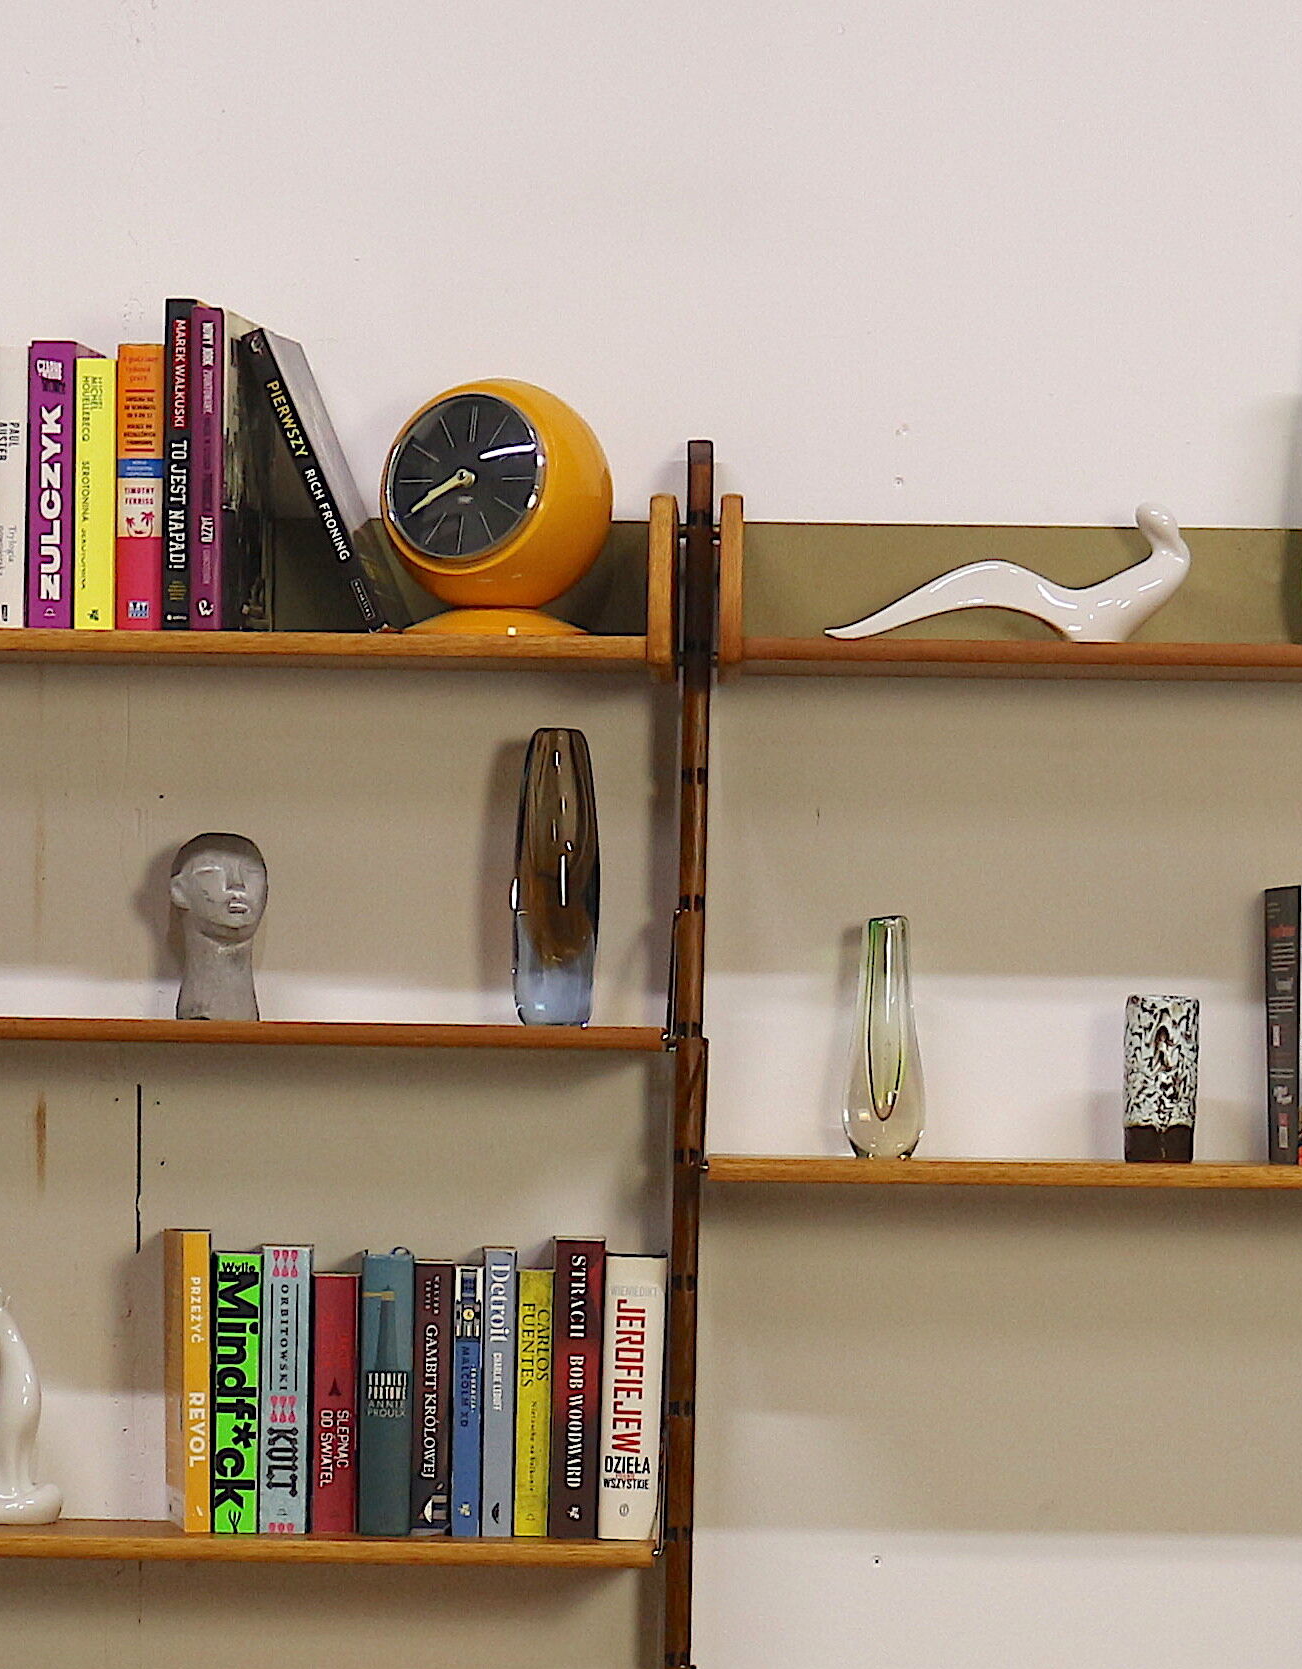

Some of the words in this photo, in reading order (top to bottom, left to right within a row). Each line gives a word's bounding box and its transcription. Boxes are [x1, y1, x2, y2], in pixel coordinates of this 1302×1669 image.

[175, 319, 187, 362] MAREK
[82, 376, 90, 442] HOUELLEBECQ
[173, 363, 186, 428] WAŁKUSKI
[266, 380, 309, 457] PIERWSZY
[9, 422, 20, 447] PAUL
[171, 440, 187, 460] TO
[81, 461, 89, 521] SEROTONINA
[170, 464, 186, 506] JEST
[304, 468, 326, 500] RICH
[319, 502, 351, 561] FRONING
[6, 526, 17, 561] Trylogia
[168, 509, 185, 569] NAPAD!
[190, 1276, 202, 1344] PRZEŻYĆ
[489, 1264, 511, 1343] Detroit
[569, 1254, 587, 1338] STRACH
[279, 1284, 289, 1391] ORBITOWSKI
[424, 1324, 438, 1389] GAMBIT
[521, 1303, 536, 1388] FUENTES
[536, 1309, 551, 1382] CARLOS
[368, 1400, 404, 1408] ANNIE
[461, 1347, 470, 1406] MALCOLM
[568, 1356, 584, 1389] BOB
[612, 1299, 646, 1454] JEROFIEJEW
[188, 1392, 205, 1468] REVOL
[320, 1409, 333, 1428] OD
[333, 1410, 350, 1468] ŚLEPNĄC
[422, 1394, 440, 1479] KRÓLOWEJ
[566, 1394, 583, 1488] WOODWARD
[269, 1426, 299, 1498] KULT
[319, 1432, 334, 1488] ŚWIATEŁ
[603, 1478, 649, 1489] WSZYSTKIE
[604, 1455, 650, 1474] DZIEŁA
